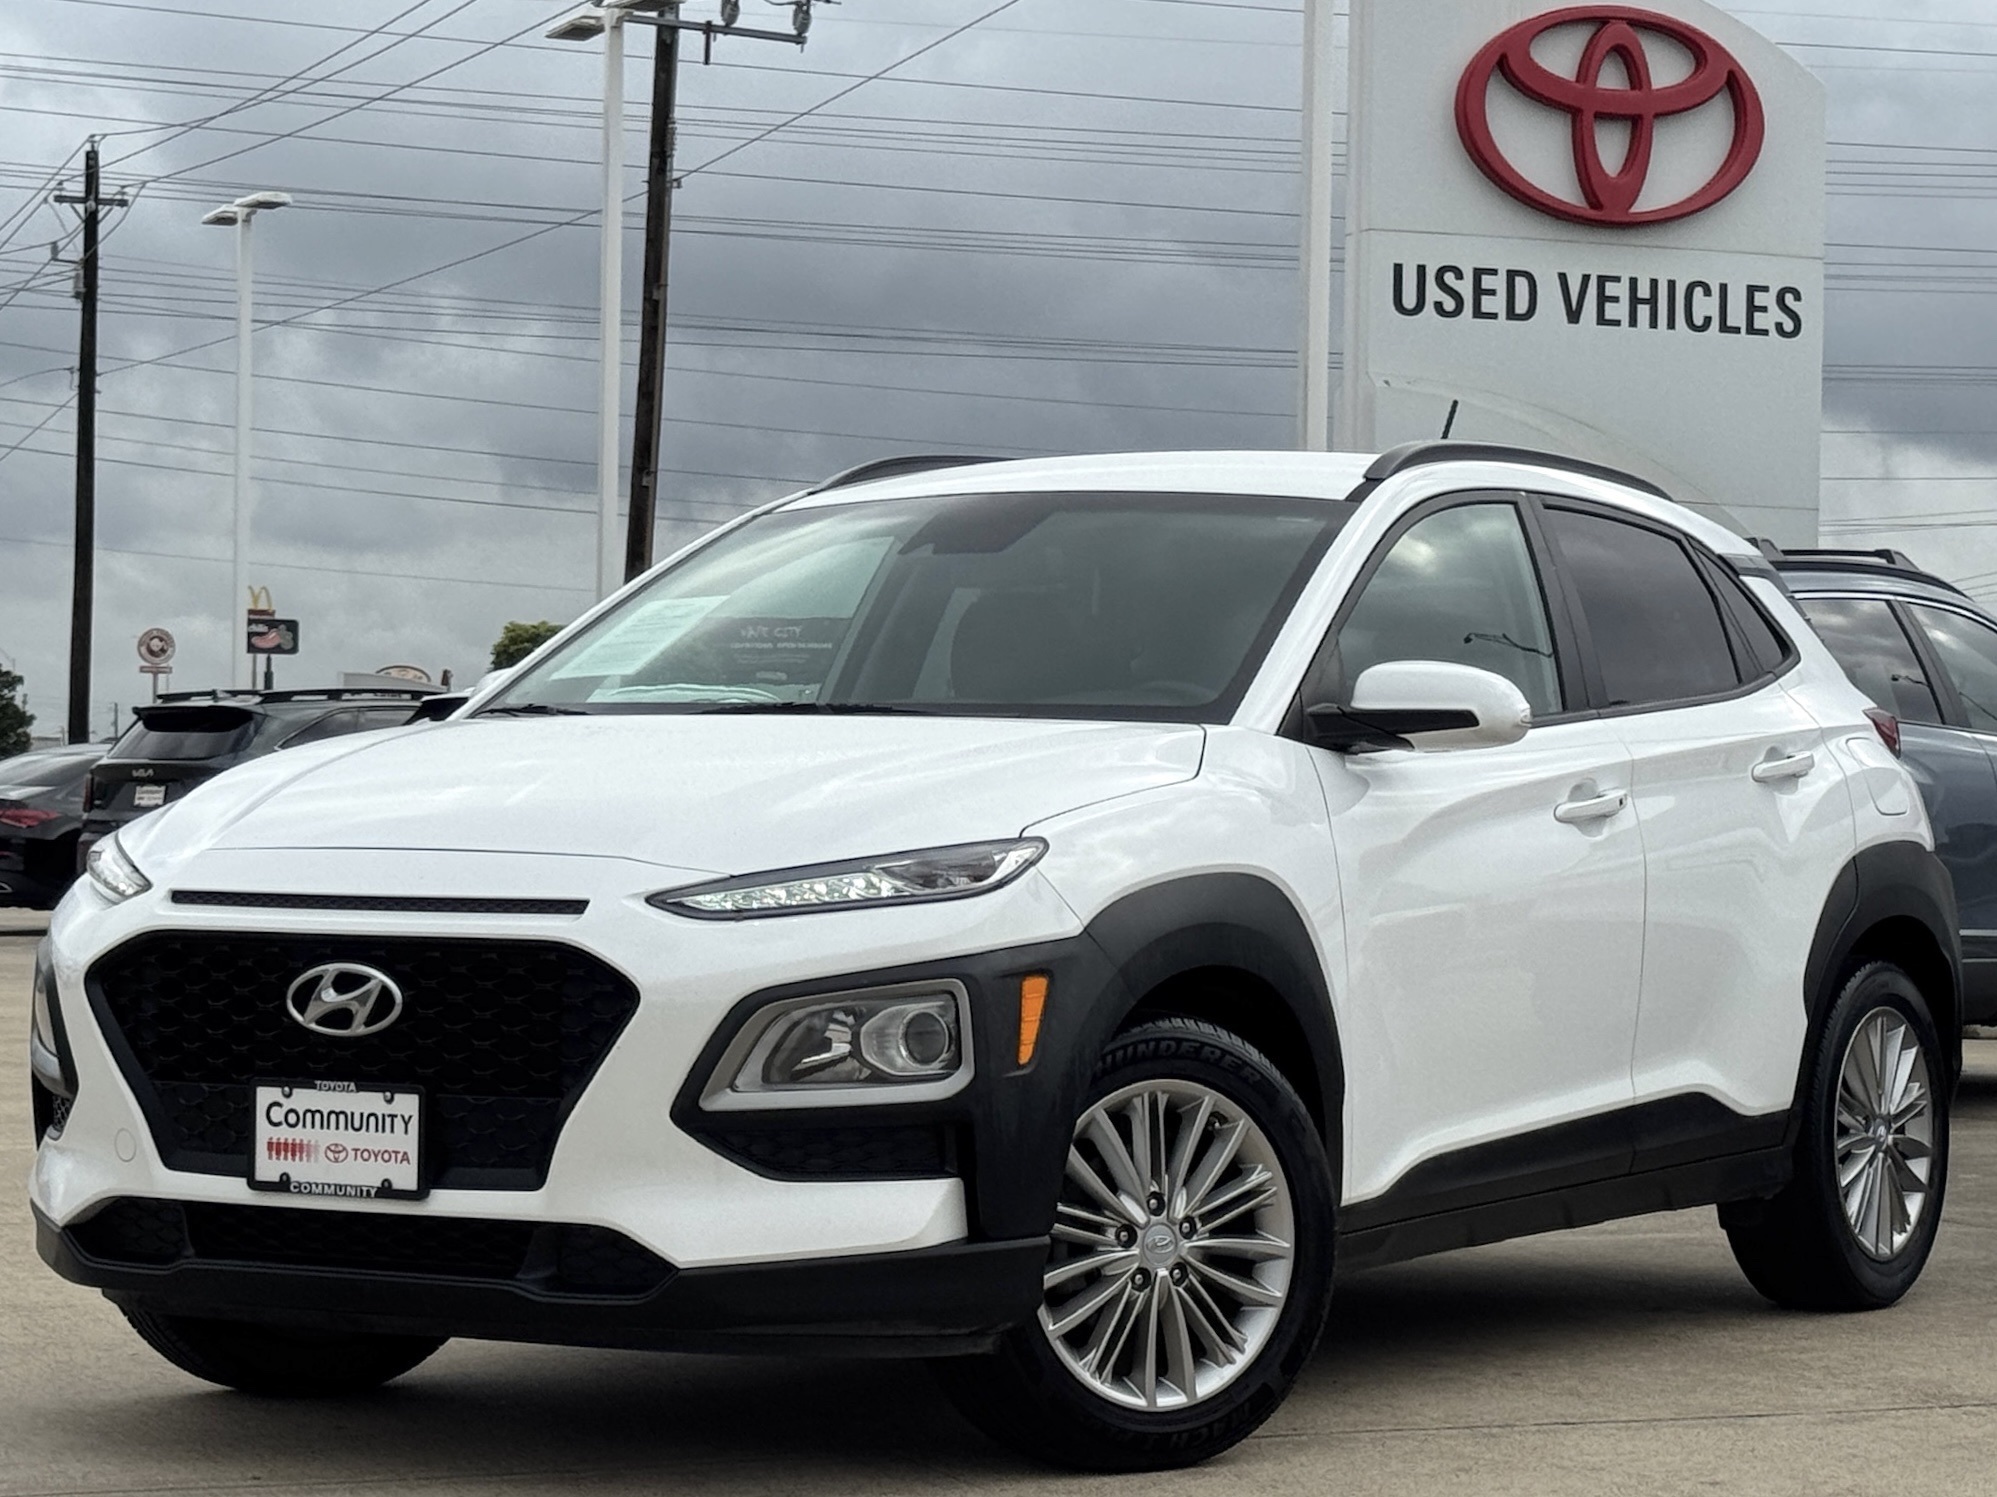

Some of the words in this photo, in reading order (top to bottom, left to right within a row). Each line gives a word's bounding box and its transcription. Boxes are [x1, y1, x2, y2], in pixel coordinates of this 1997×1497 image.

[1392, 262, 1538, 321] USED
[1557, 271, 1803, 339] VEHICLES
[314, 1080, 358, 1093] TOYOTA
[351, 1147, 411, 1165] TOYOTA
[290, 1181, 378, 1198] COMMUNITY
